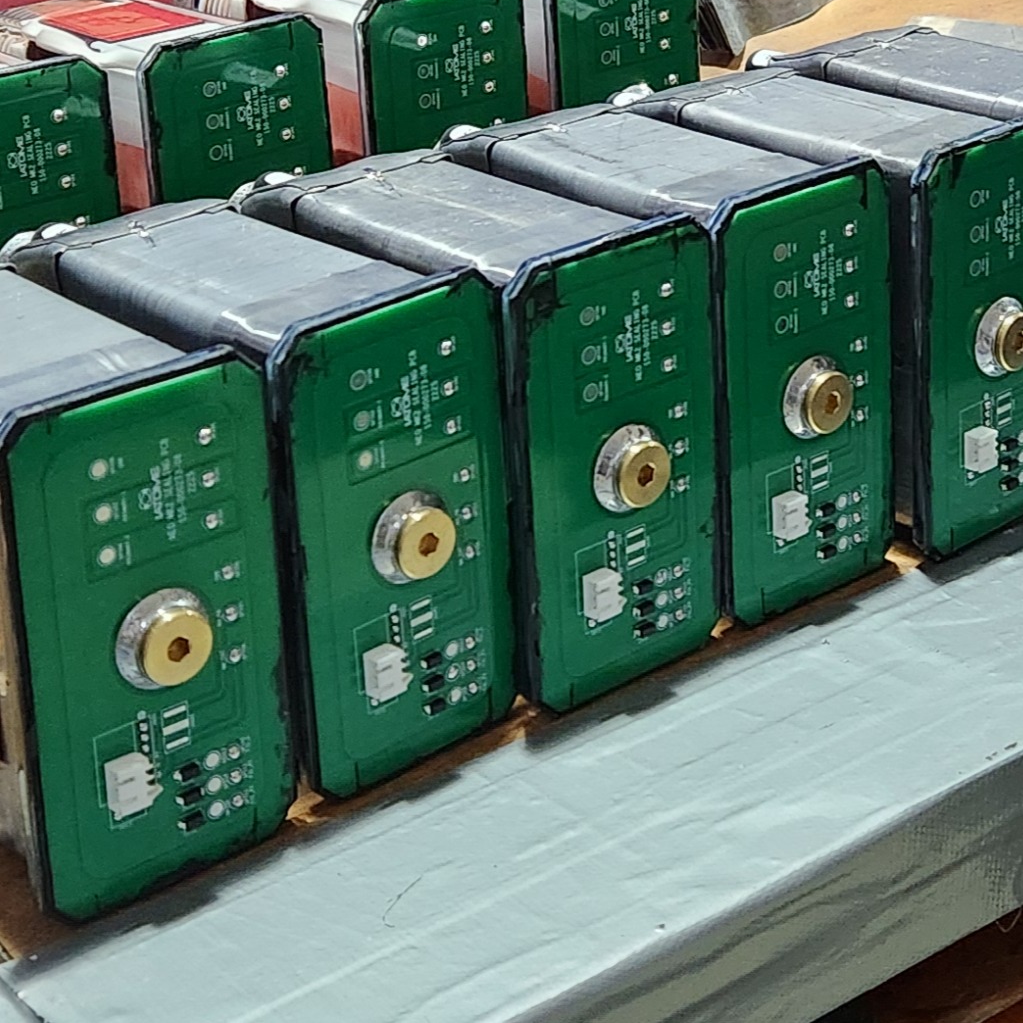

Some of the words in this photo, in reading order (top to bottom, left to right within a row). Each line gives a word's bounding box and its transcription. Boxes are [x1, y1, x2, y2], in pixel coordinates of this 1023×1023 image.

[452, 43, 460, 81] IATOME
[244, 90, 254, 130] IATOME
[251, 86, 260, 115] SEALING
[22, 115, 30, 129] PCB
[15, 136, 28, 177] IATOME
[24, 131, 34, 161] SEALING
[44, 142, 54, 159] 2225
[30, 180, 38, 194] NEO
[624, 314, 633, 362] IATOME
[400, 375, 412, 428] IATOME
[150, 465, 163, 520] IATOME
